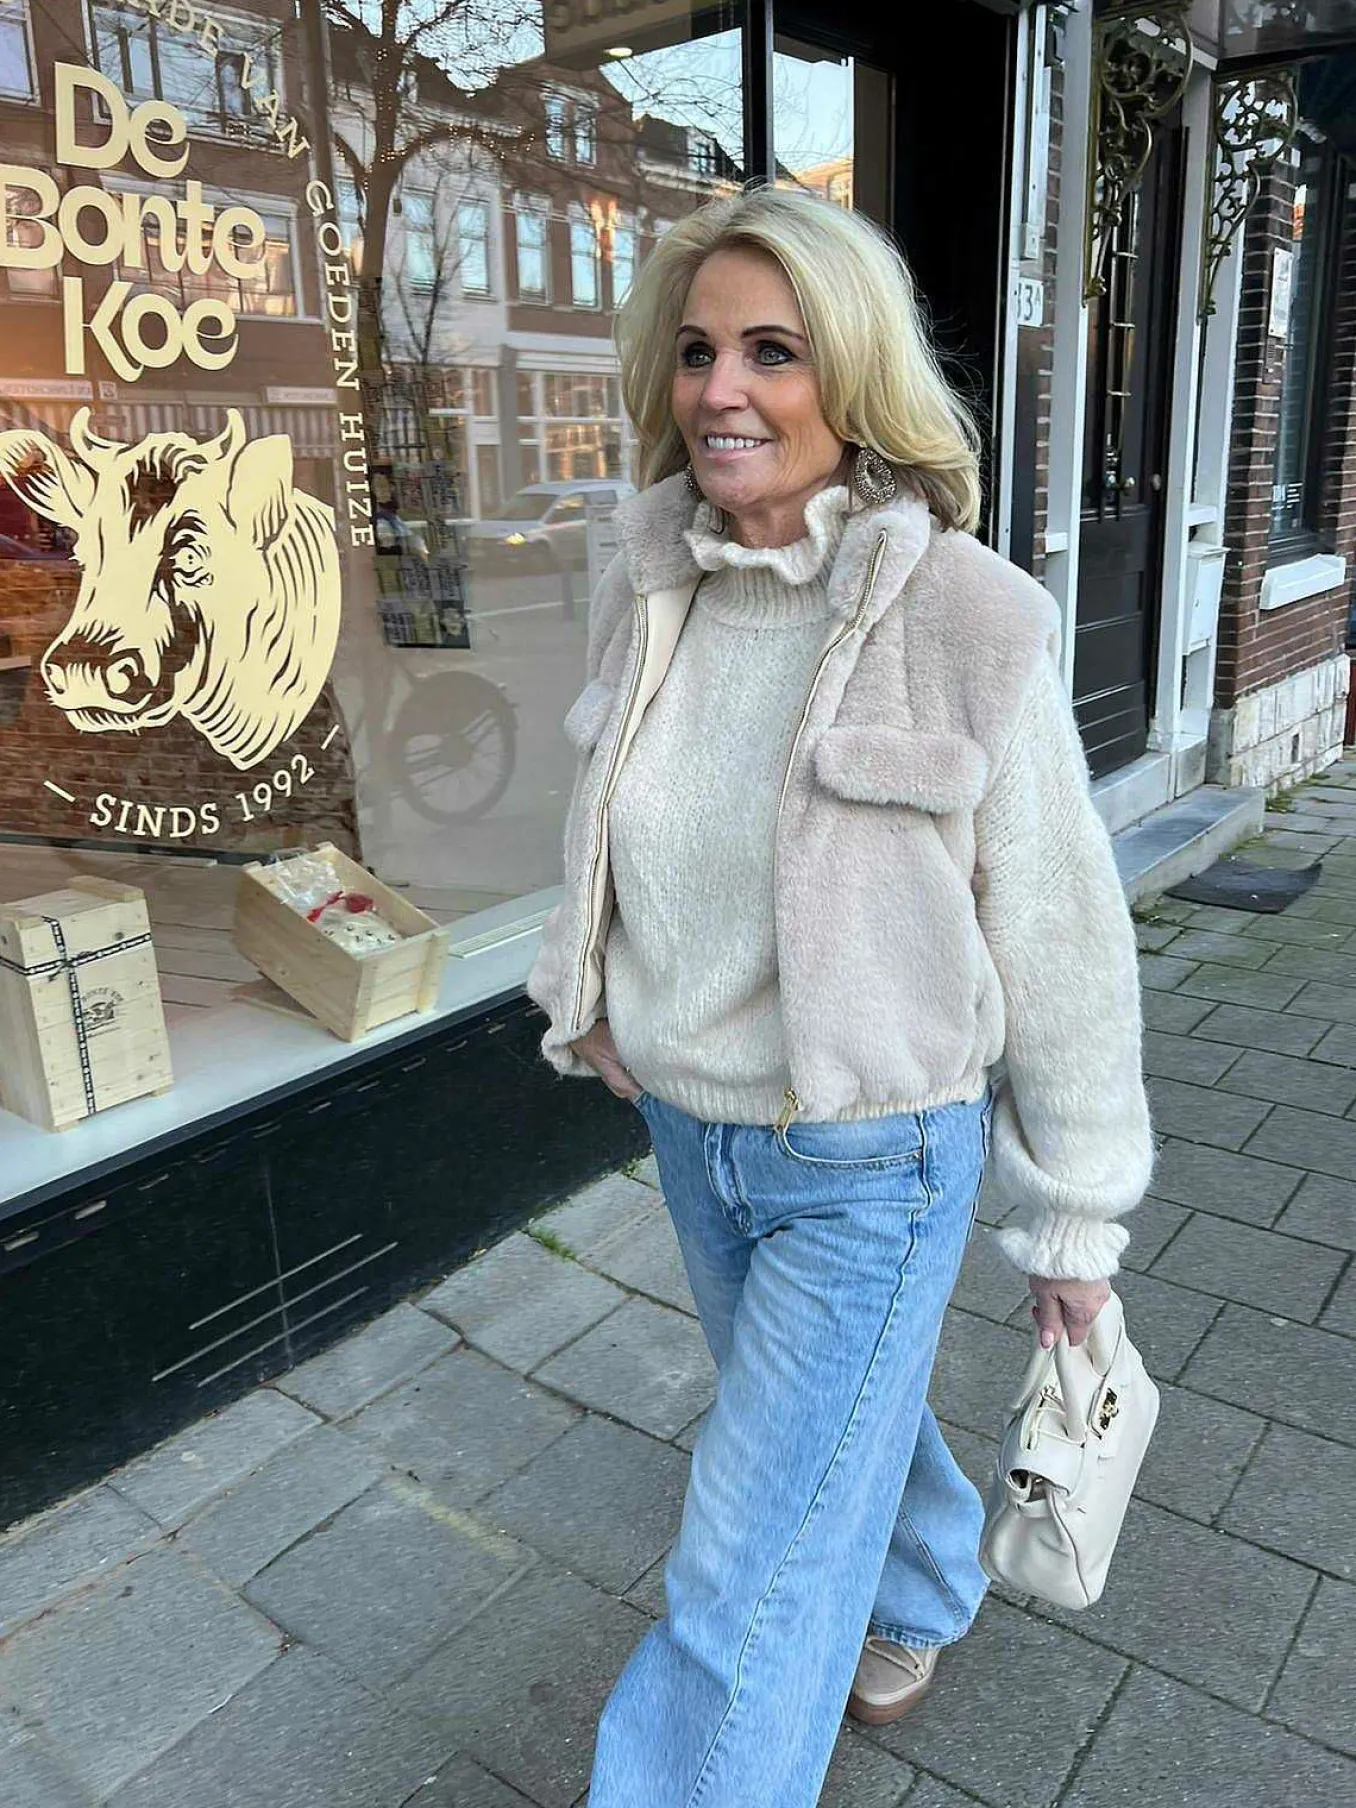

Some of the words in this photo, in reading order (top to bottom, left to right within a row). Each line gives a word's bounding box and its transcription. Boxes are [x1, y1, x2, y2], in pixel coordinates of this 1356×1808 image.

[54, 61, 190, 178] De
[0, 163, 267, 279] Bonte
[62, 276, 239, 383] Koe
[240, 52, 311, 159] VAN
[306, 180, 361, 391] GOEDEN
[340, 412, 376, 548] HUIZE
[1017, 282, 1042, 321] 3A
[89, 792, 221, 838] SINDS
[235, 753, 316, 822] 1992
